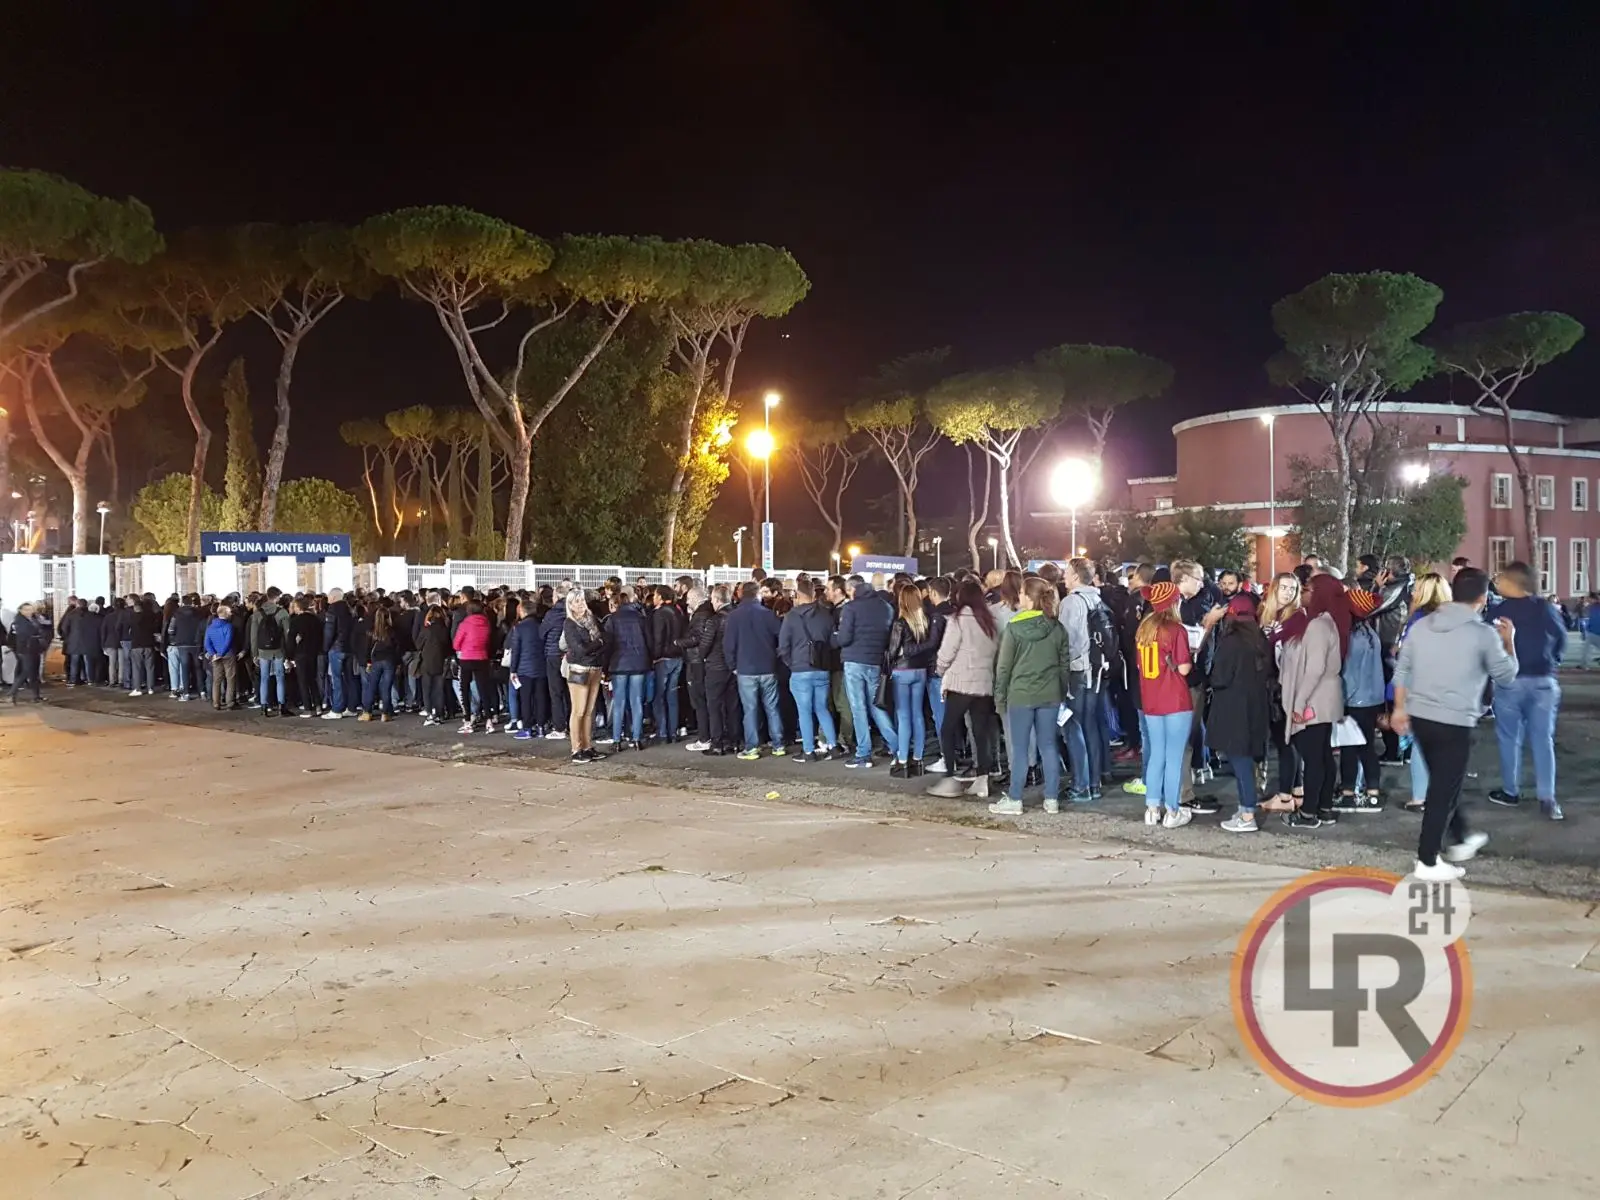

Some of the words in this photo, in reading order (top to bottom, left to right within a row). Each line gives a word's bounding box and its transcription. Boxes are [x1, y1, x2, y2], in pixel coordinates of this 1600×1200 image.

[213, 541, 263, 552] TRIBUNA
[265, 542, 304, 553] MONTE
[306, 543, 341, 553] MARIO
[1137, 641, 1160, 679] 10
